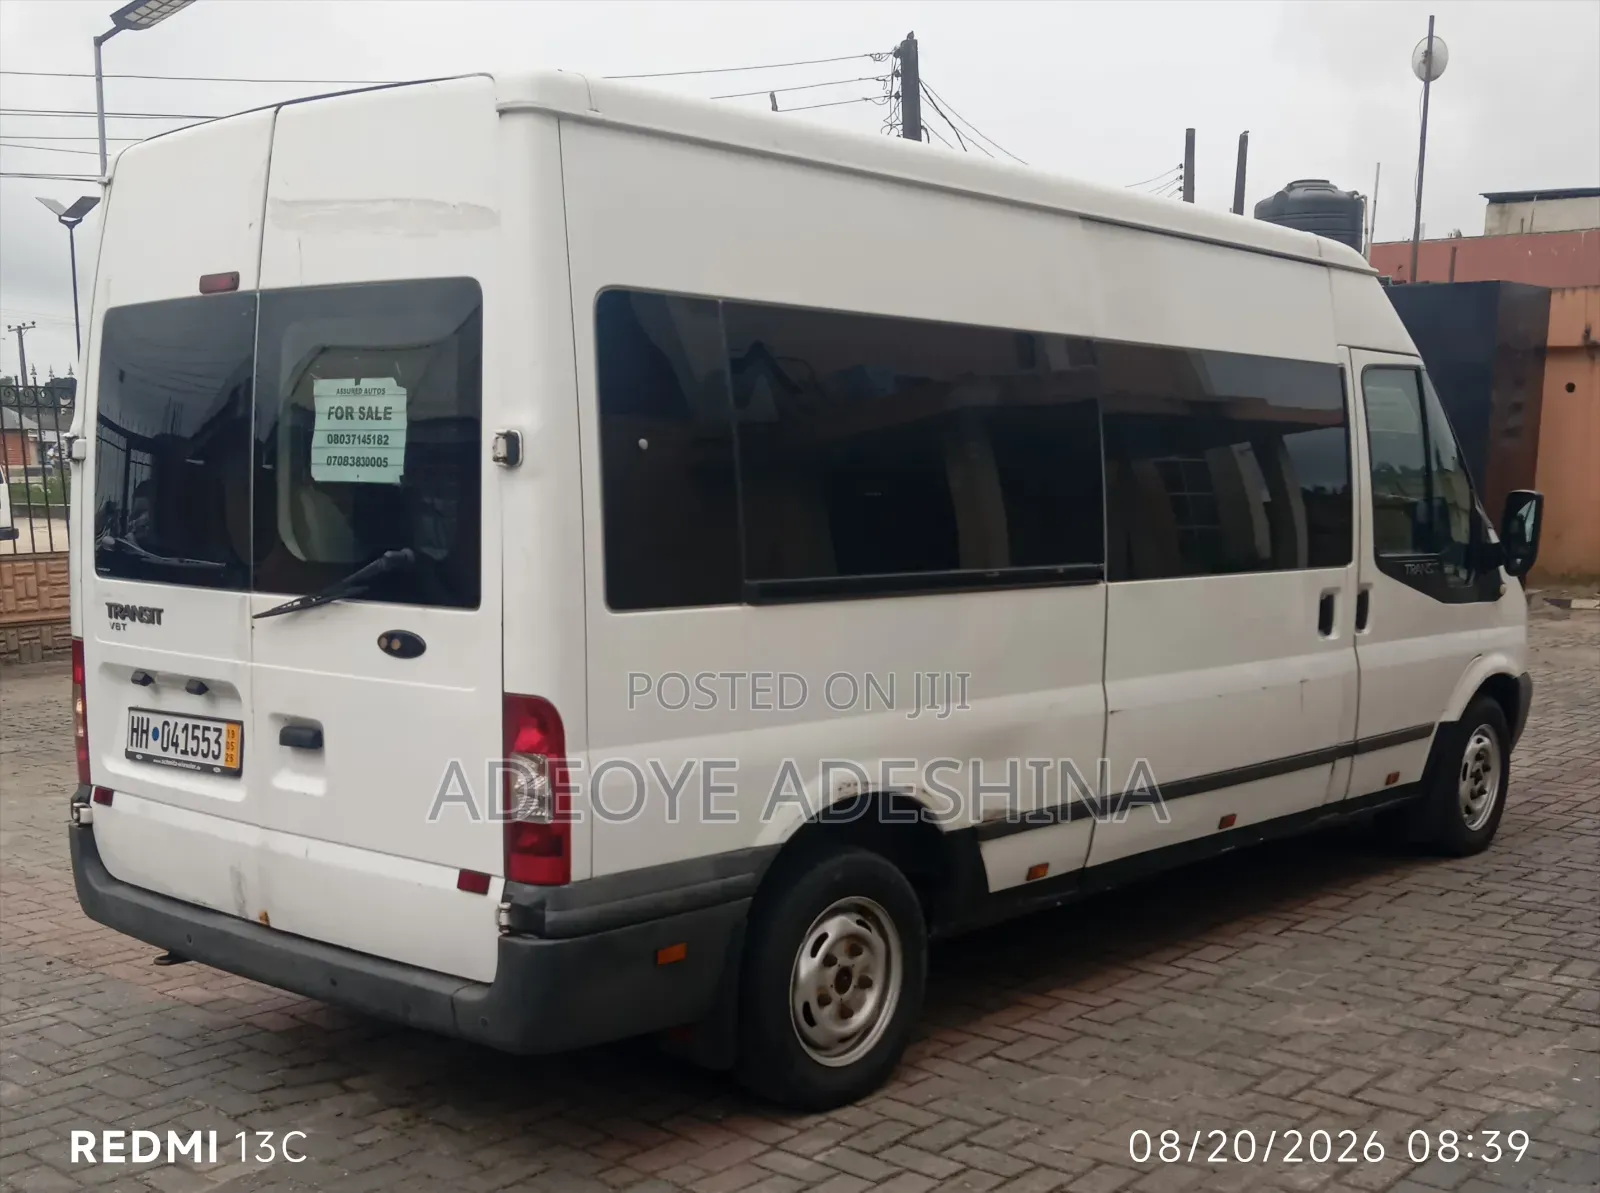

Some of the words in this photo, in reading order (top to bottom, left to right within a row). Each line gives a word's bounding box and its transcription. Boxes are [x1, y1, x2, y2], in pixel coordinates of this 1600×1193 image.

[336, 387, 362, 395] ASSURED
[327, 406, 355, 420] FOR
[358, 406, 393, 420] SALE
[327, 433, 390, 446] 08037145182
[326, 455, 389, 468] 07083830005
[105, 602, 165, 626] TRANSIT
[129, 715, 150, 750] HH
[160, 720, 223, 761] 041553
